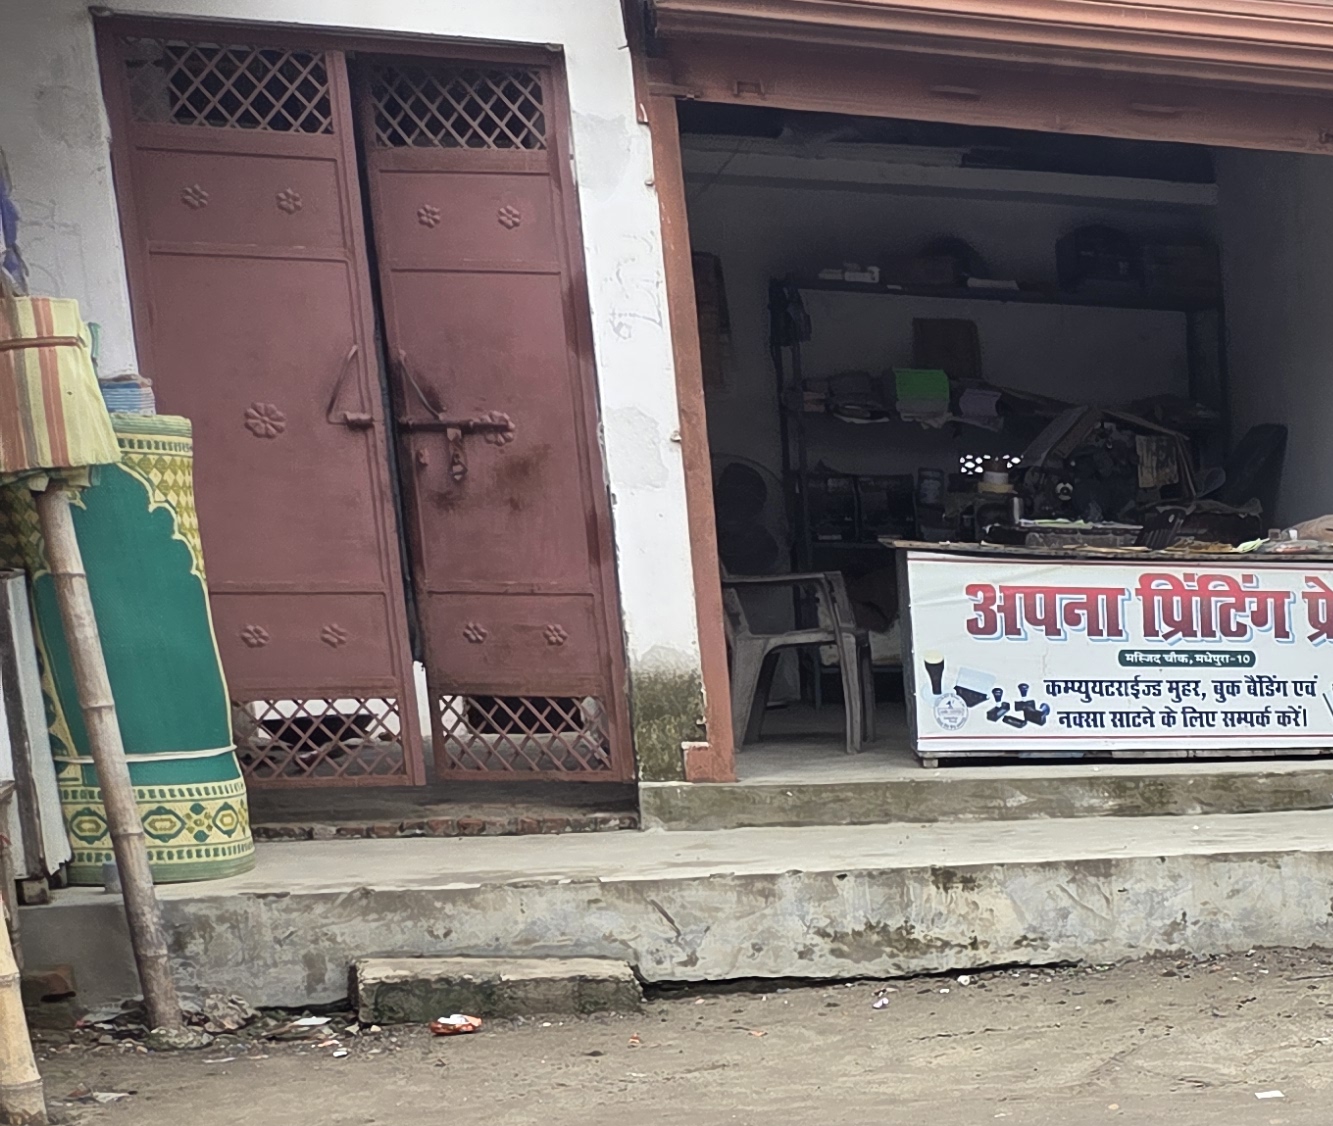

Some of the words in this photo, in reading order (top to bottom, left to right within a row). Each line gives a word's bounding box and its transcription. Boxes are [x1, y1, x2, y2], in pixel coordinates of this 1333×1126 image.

[965, 583, 1131, 642] अपना
[1135, 573, 1296, 646] प्रिंटिंग
[1166, 680, 1207, 703] मुहर,
[1211, 680, 1242, 703] बुक
[1291, 675, 1318, 697] एवं
[1057, 711, 1106, 728] नक्सा
[1109, 706, 1156, 728] साटने
[1159, 706, 1178, 727] के
[1181, 706, 1218, 727] लिए
[1221, 706, 1272, 727] सम्पर्क
